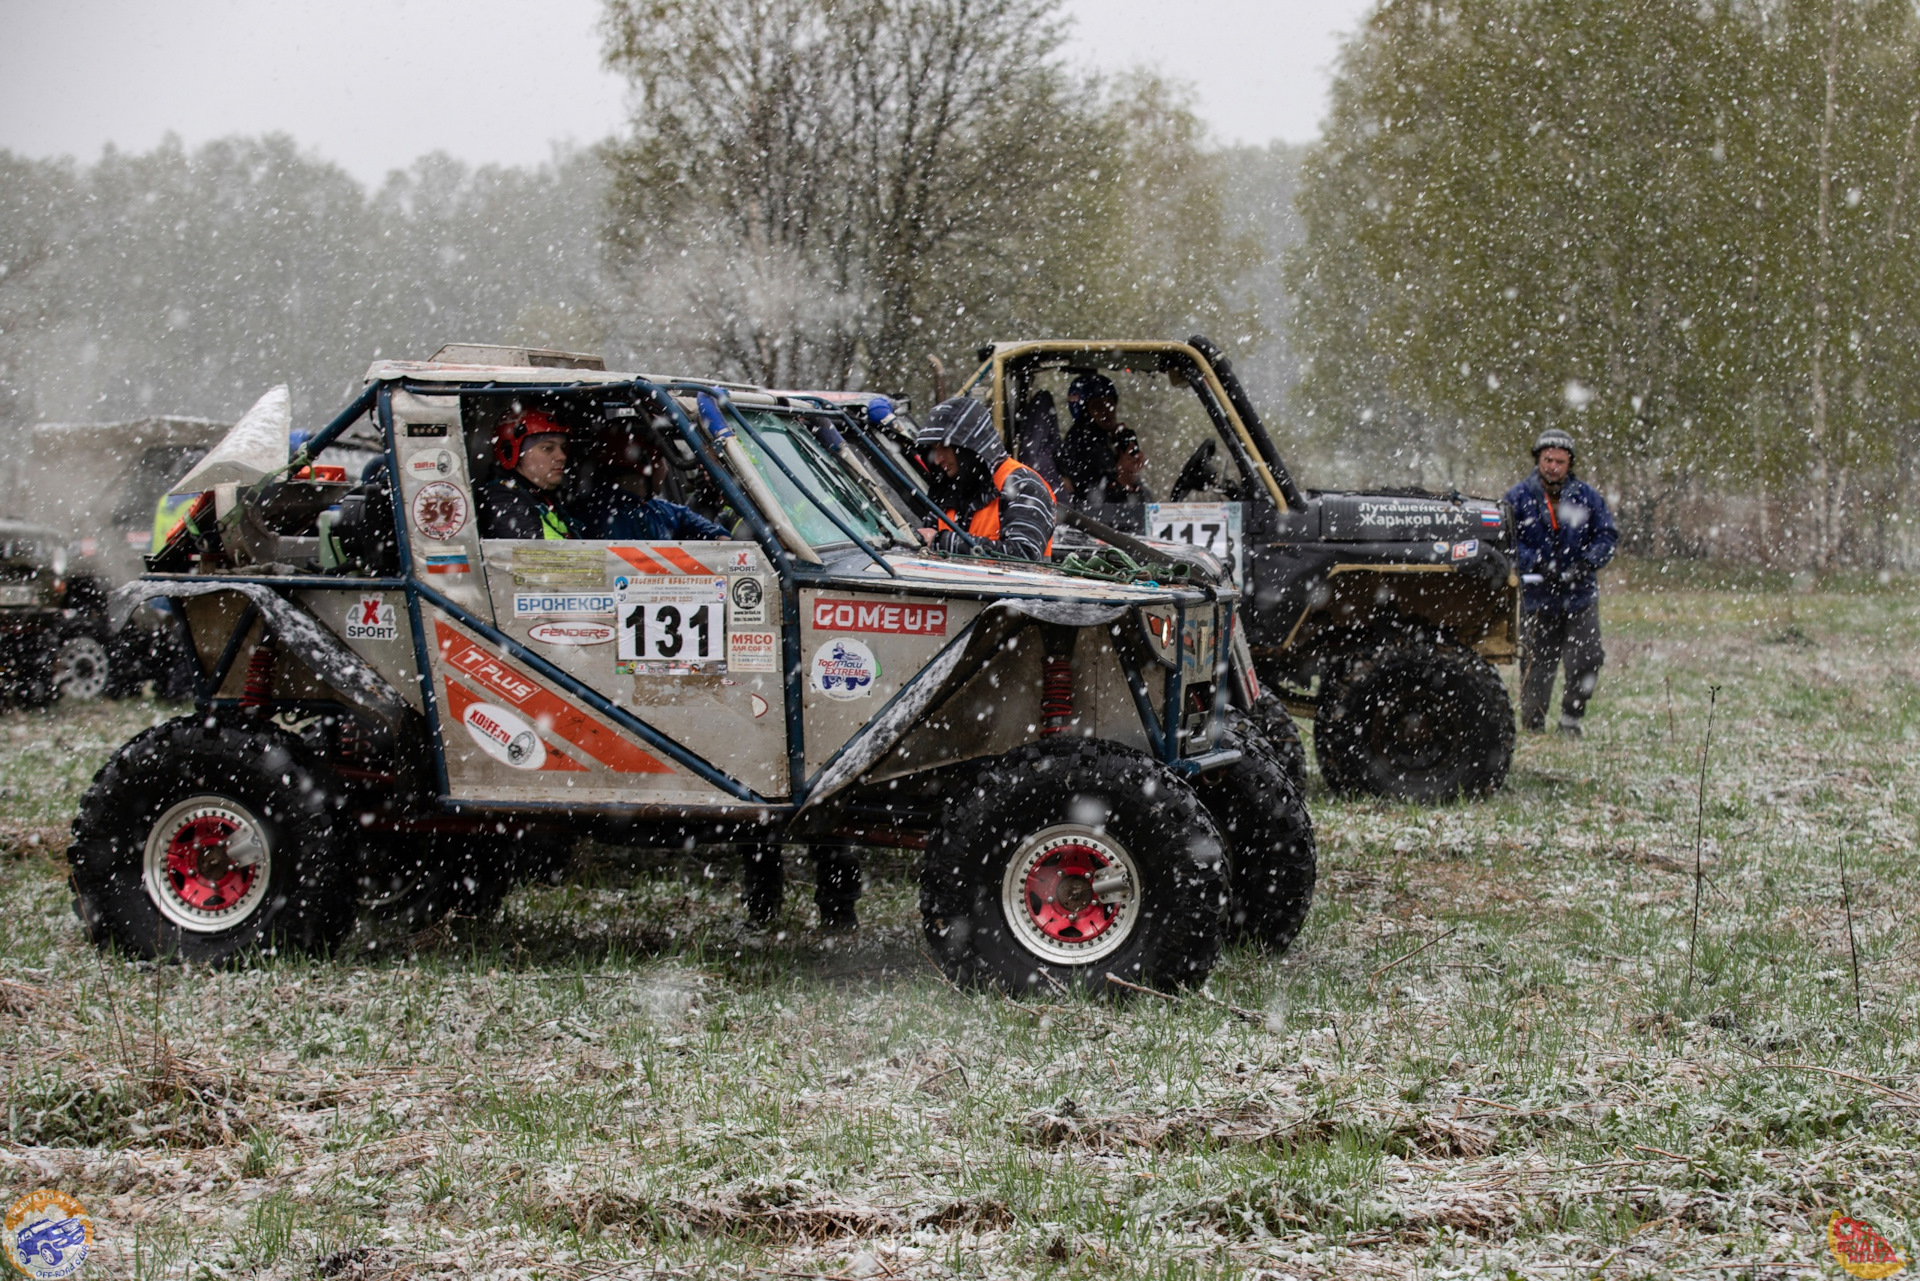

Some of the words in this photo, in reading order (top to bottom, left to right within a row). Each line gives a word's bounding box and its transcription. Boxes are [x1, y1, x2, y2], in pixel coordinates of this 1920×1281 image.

[1435, 513, 1469, 526] И.А.
[517, 597, 614, 612] БРОНЕКОР
[815, 604, 945, 631] COMEUP
[348, 625, 394, 638] SPORT
[540, 628, 611, 639] FENDERS
[626, 605, 709, 658] 131
[731, 634, 773, 644] МЯСО
[463, 650, 485, 664] T
[480, 663, 532, 698] PLUS
[825, 667, 868, 677] EXTREME
